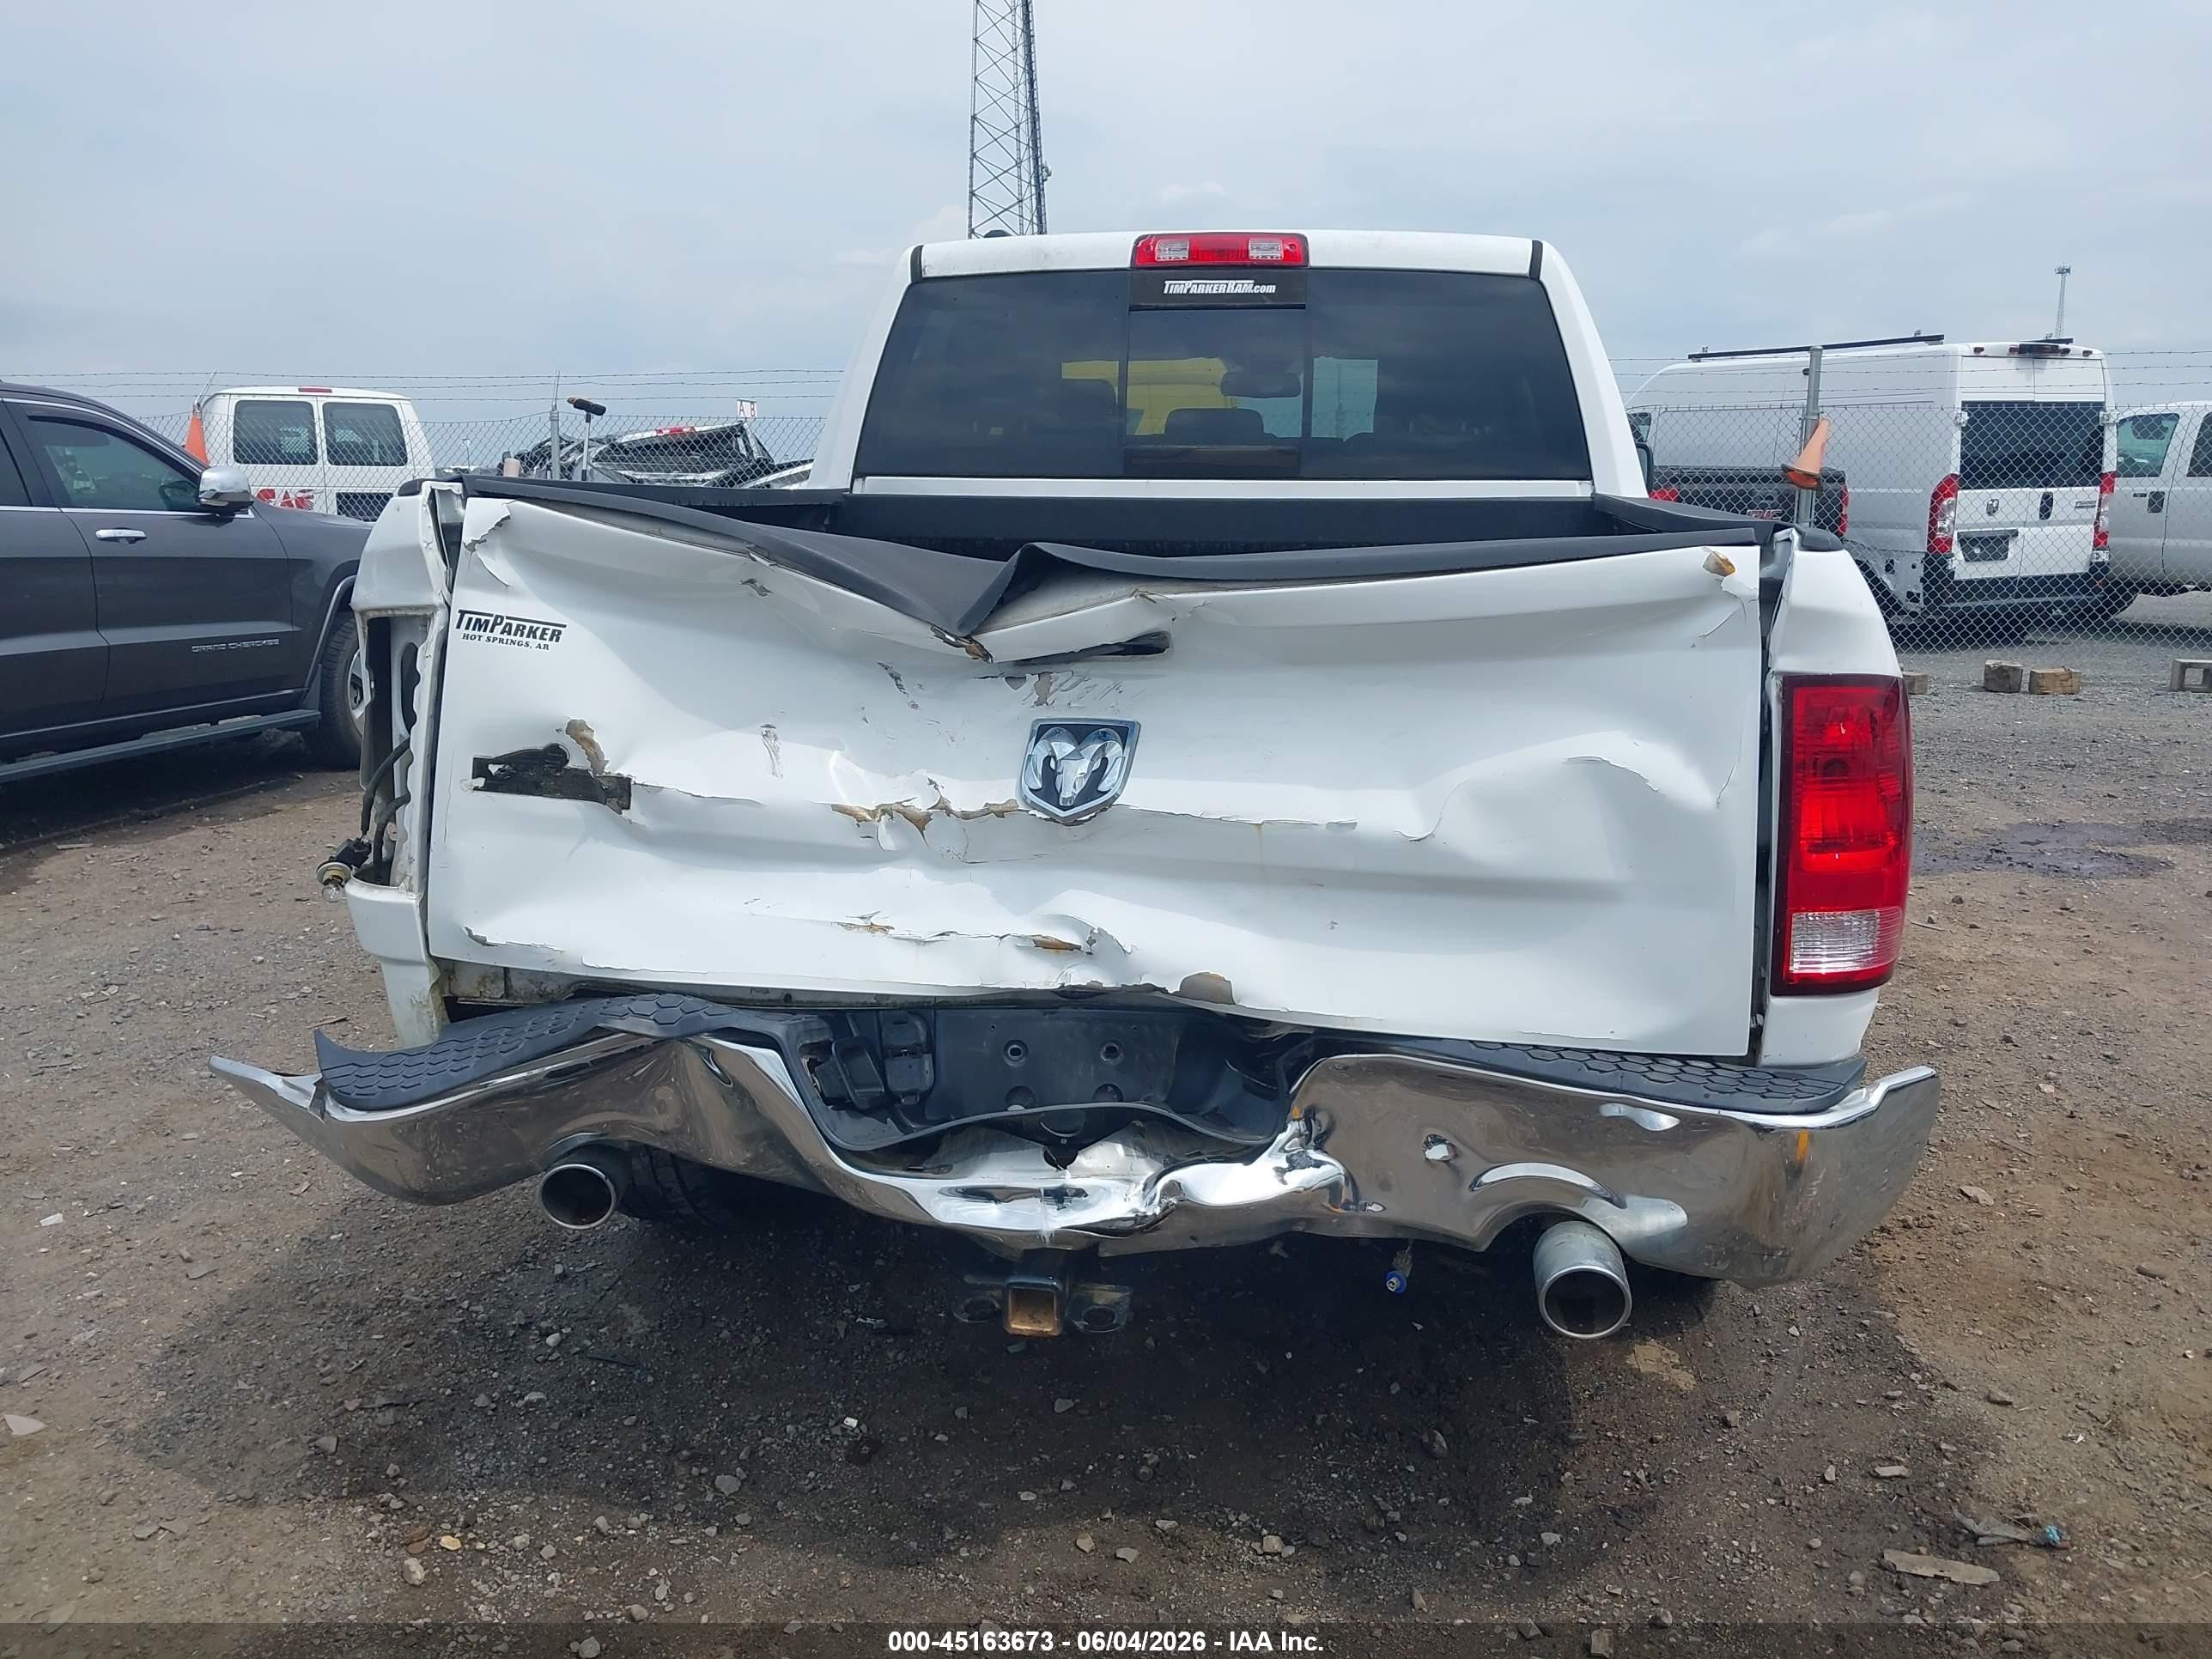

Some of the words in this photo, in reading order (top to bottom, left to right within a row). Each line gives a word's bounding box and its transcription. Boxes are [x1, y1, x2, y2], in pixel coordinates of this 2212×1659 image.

[738, 400, 745, 416] A
[750, 401, 756, 417] B
[455, 609, 567, 643] TIMPARKER
[461, 633, 483, 641] HOT
[485, 635, 533, 650] SPRINGS,
